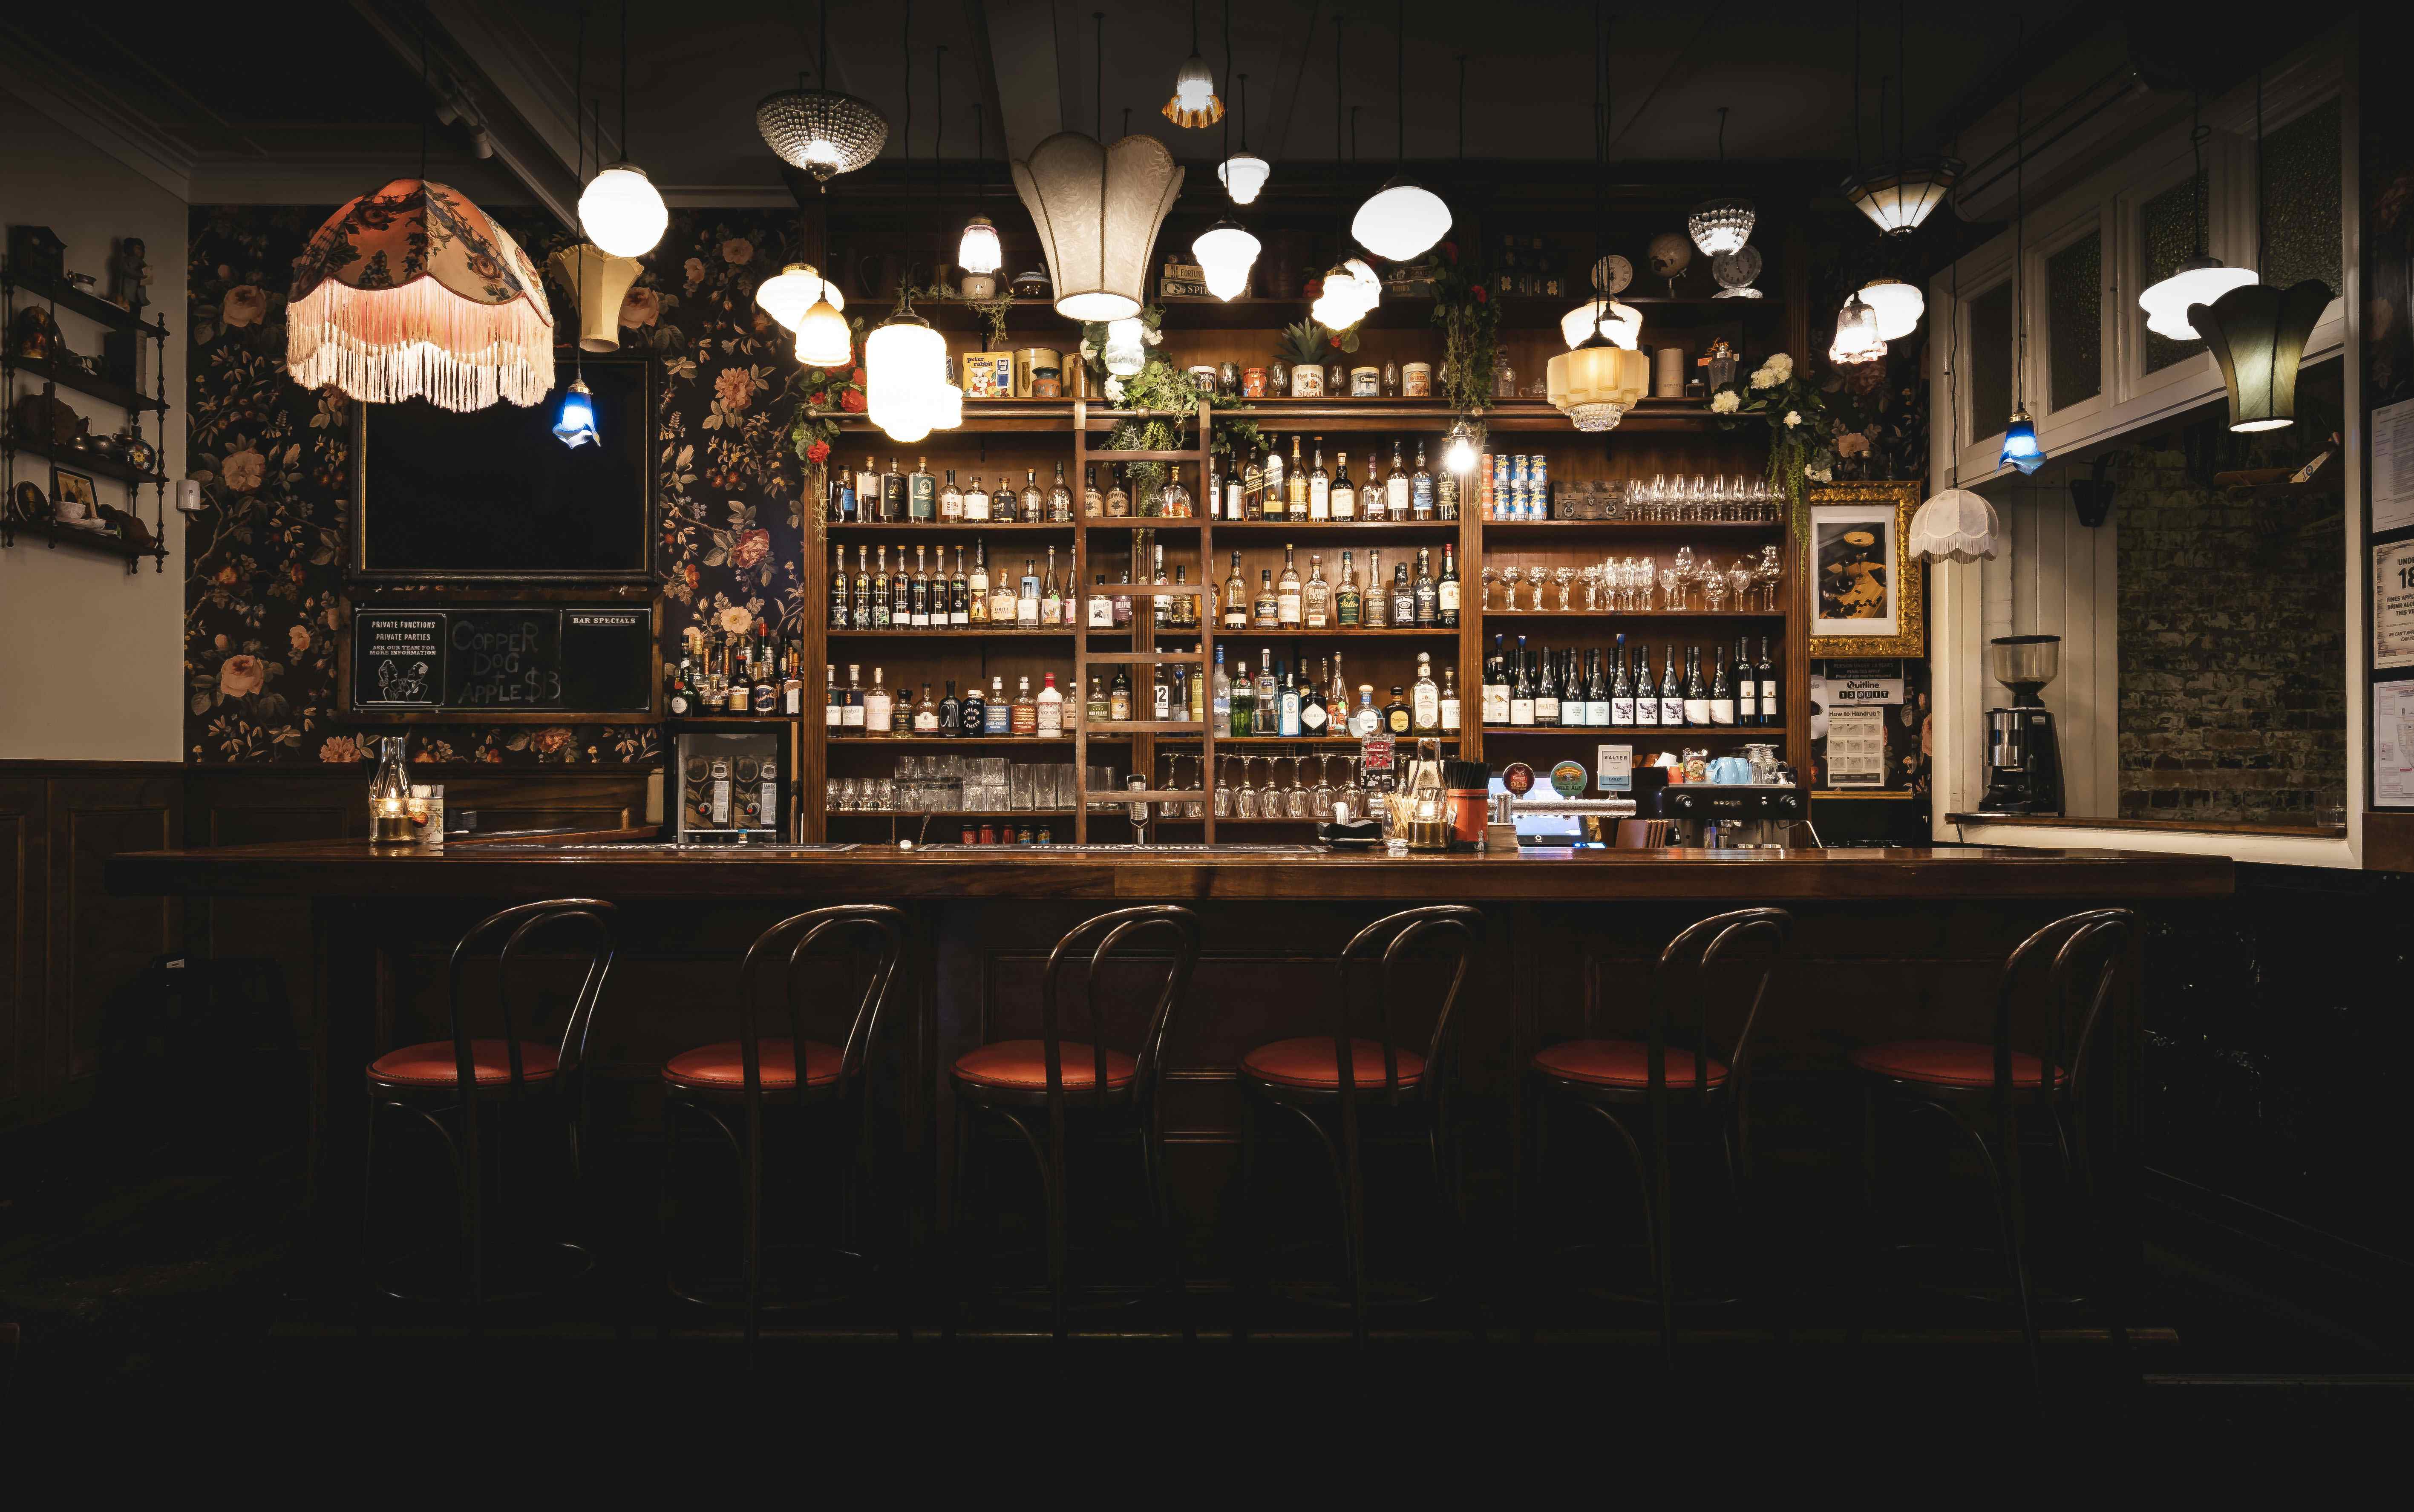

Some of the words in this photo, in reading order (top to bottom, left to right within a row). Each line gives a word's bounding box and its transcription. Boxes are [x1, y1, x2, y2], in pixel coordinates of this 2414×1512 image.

[1340, 599, 1359, 608] Weller
[1847, 681, 1880, 689] Quitline
[457, 682, 521, 704] APPLE
[940, 704, 959, 727] GIN
[965, 720, 980, 728] SMITH
[1365, 756, 1388, 769] IPA
